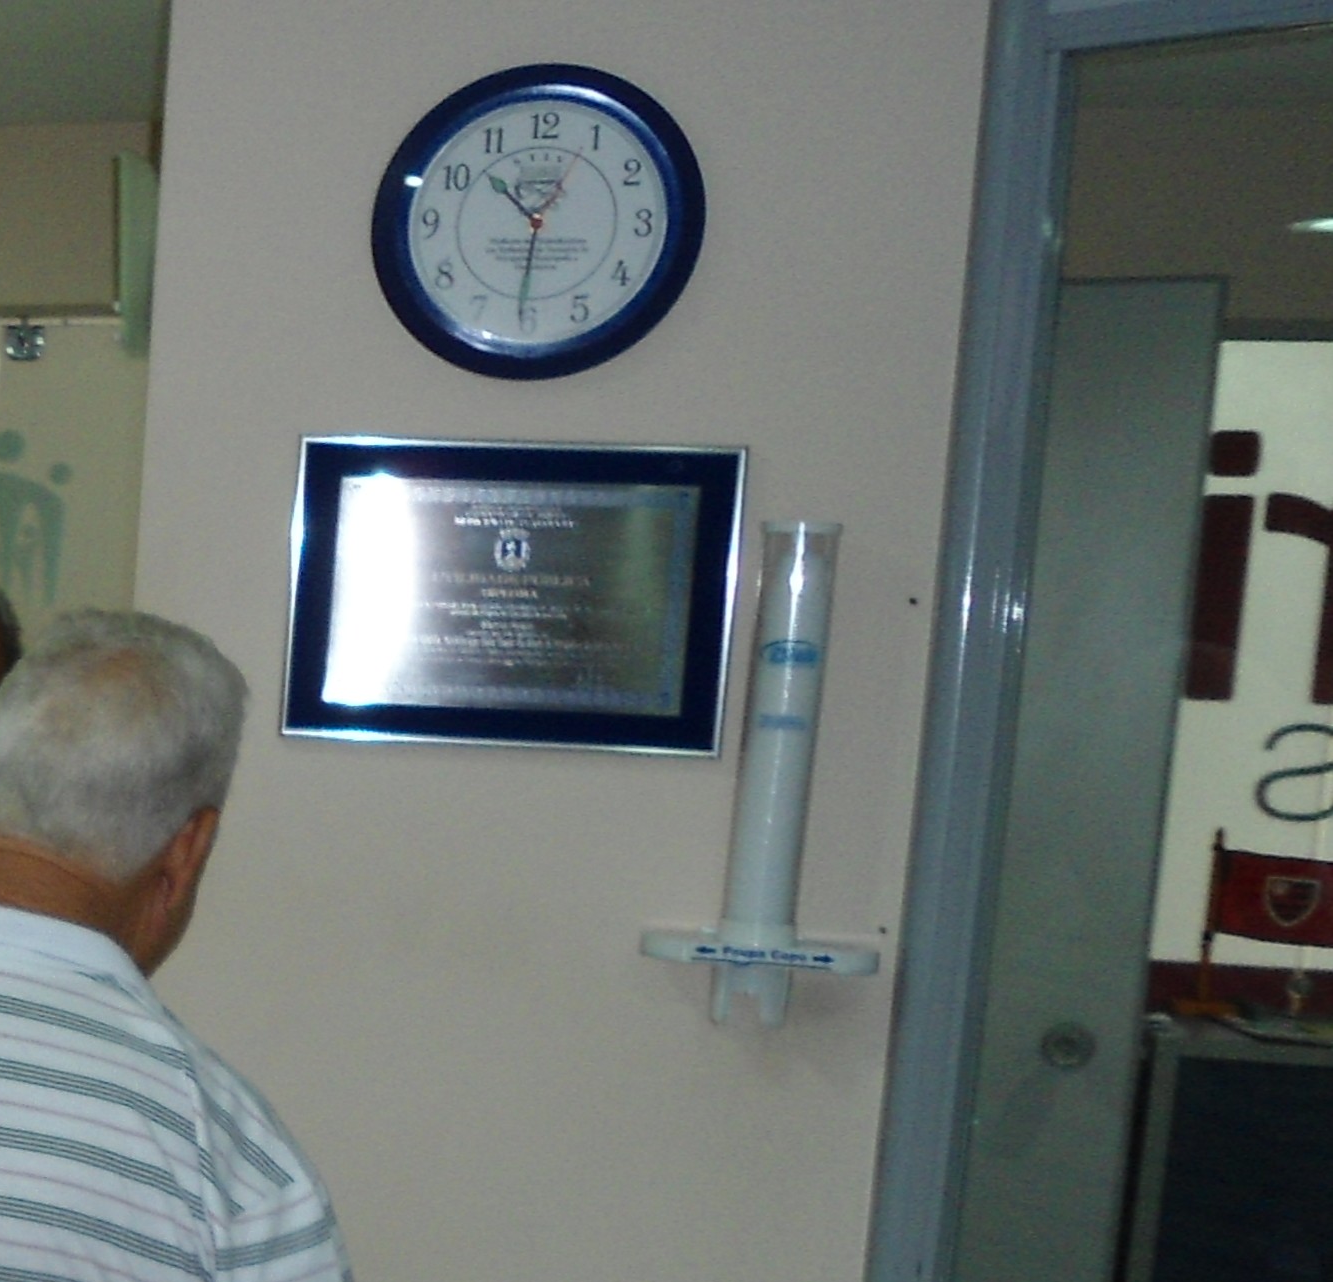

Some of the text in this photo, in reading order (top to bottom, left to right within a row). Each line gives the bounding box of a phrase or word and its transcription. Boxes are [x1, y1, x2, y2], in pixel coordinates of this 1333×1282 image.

[530, 111, 560, 140] 12
[590, 123, 601, 151] 1
[484, 127, 504, 154] 11
[442, 163, 471, 192] 10
[622, 158, 642, 187] 2
[421, 208, 440, 240] 9
[633, 208, 653, 238] 3
[435, 257, 455, 291] 8
[610, 259, 631, 287] 4
[468, 294, 489, 324] 7
[519, 304, 538, 333] 6
[569, 294, 590, 324] 5
